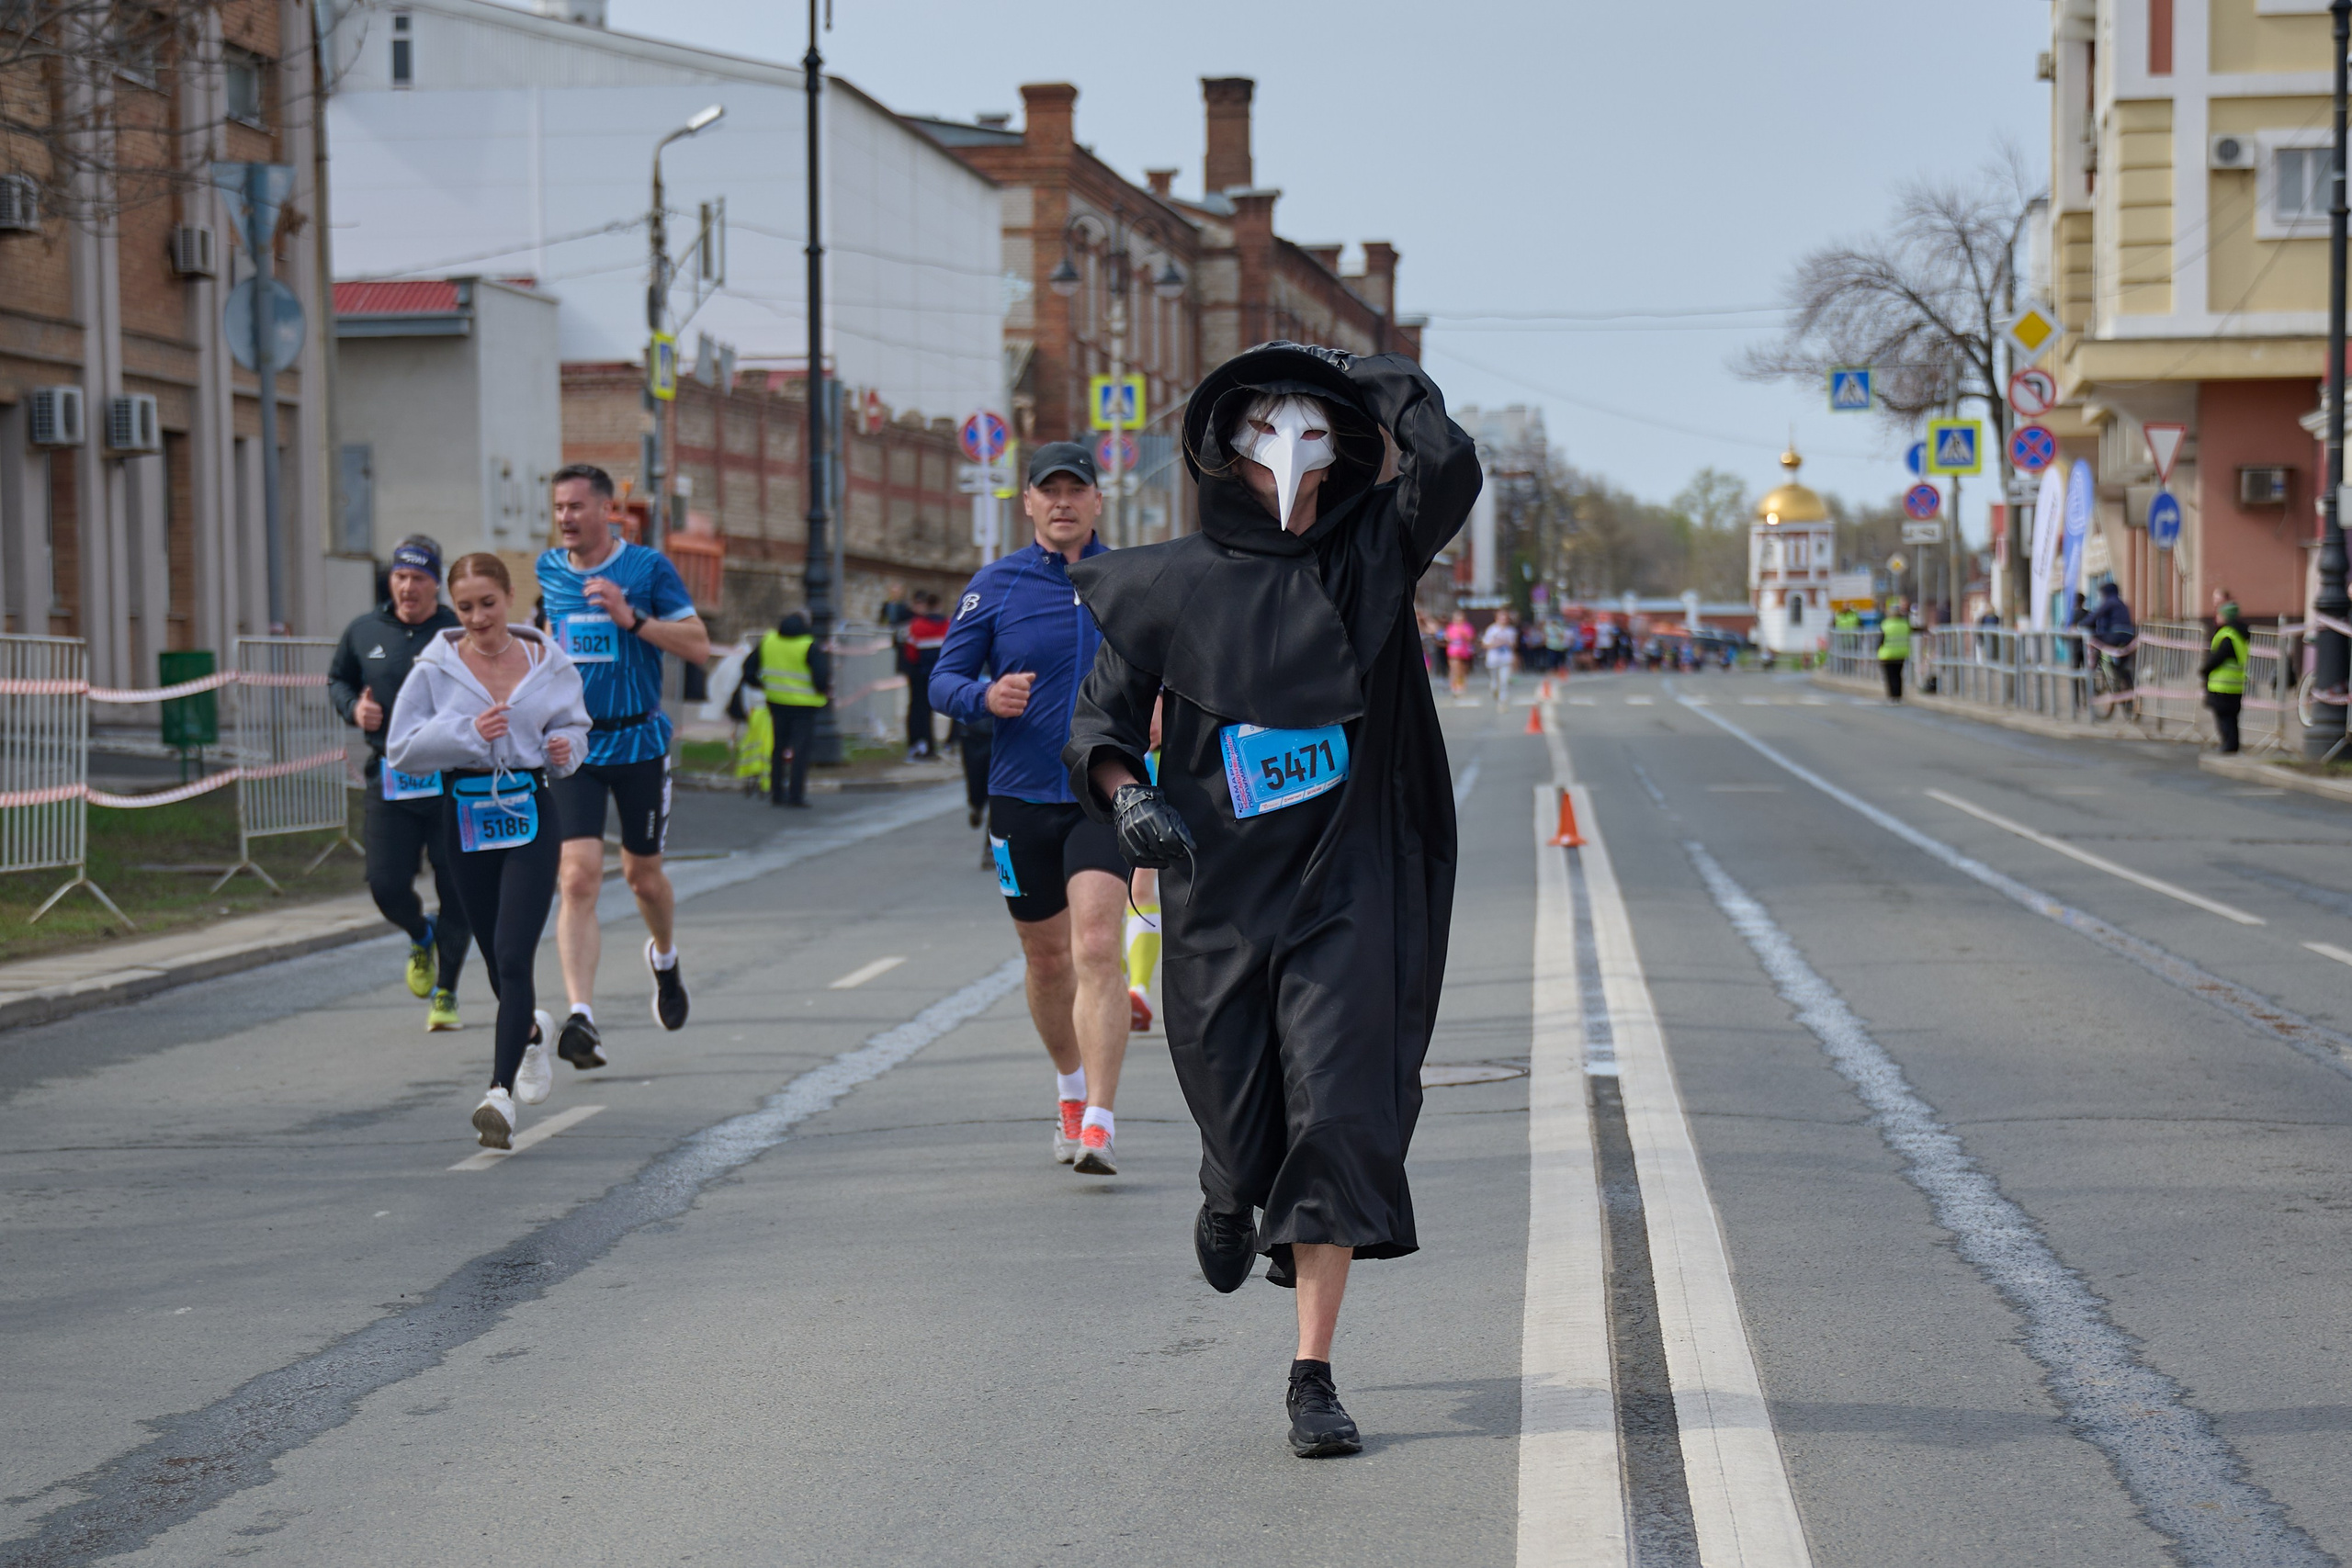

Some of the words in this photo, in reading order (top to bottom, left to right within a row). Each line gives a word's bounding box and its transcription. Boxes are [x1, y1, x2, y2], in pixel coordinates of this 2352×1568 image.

[572, 635, 611, 653] 5021
[1223, 735, 1243, 810] САМАРСКИЙ
[1231, 734, 1254, 807] ПОЛУМАРАФОН
[1261, 739, 1336, 790] 5471
[482, 817, 530, 839] 5186
